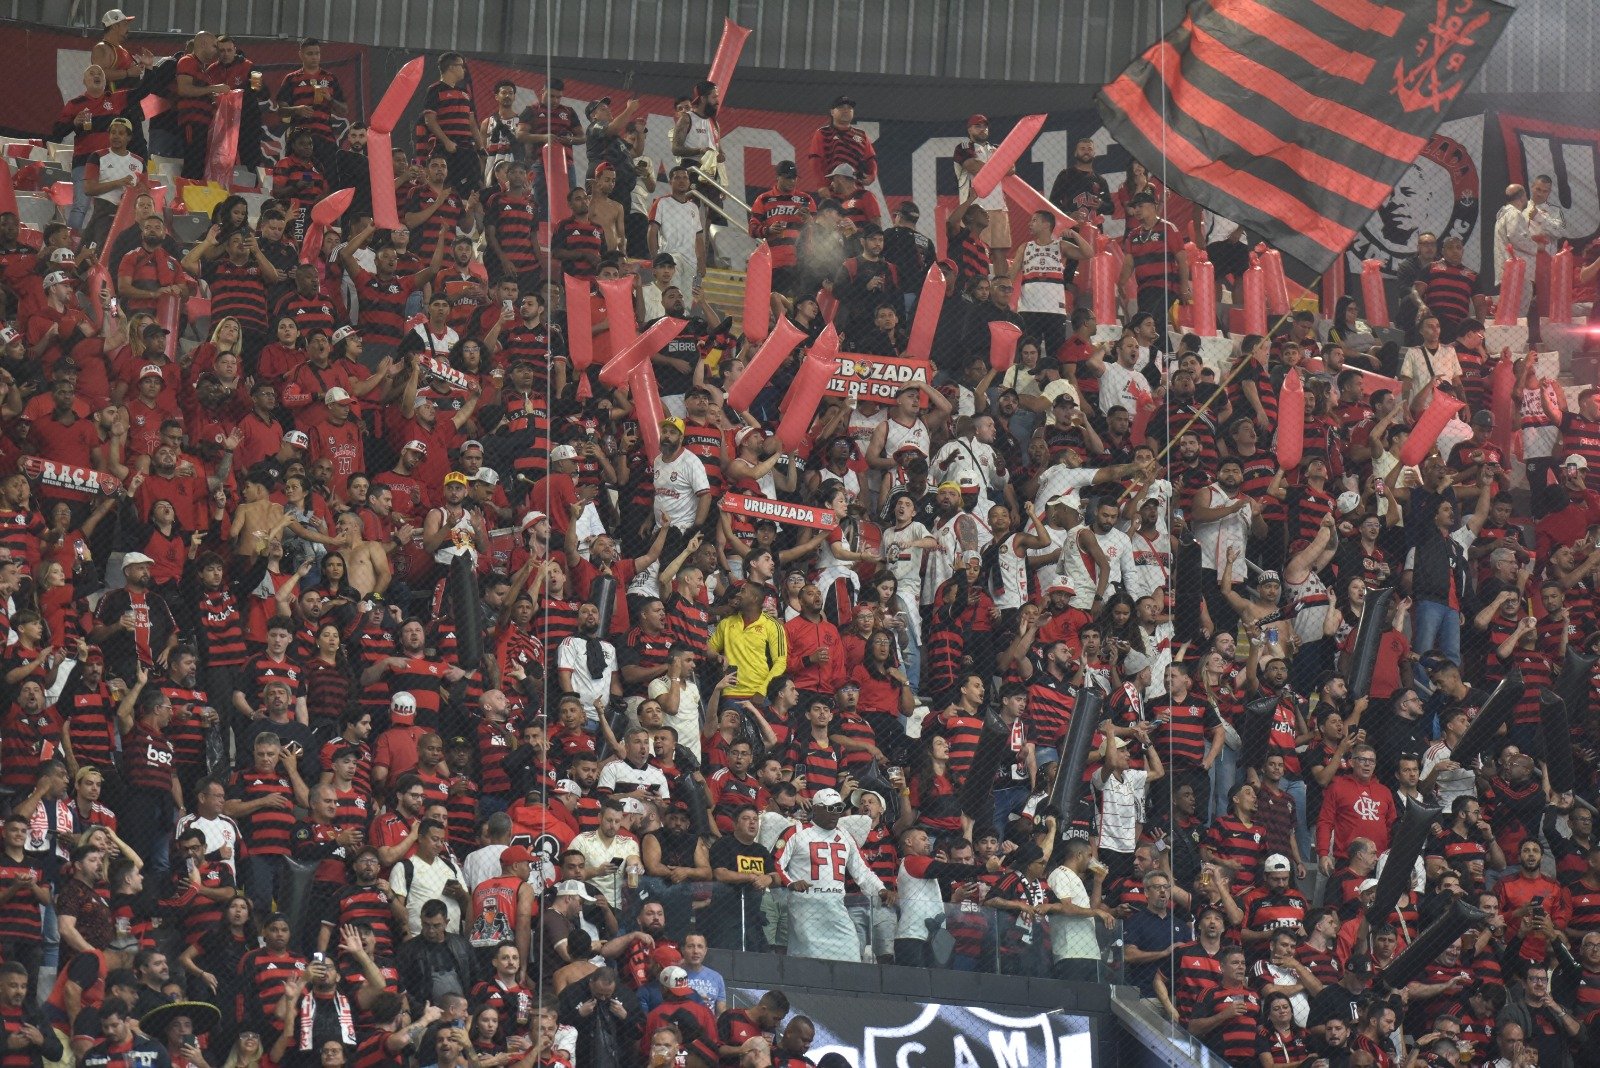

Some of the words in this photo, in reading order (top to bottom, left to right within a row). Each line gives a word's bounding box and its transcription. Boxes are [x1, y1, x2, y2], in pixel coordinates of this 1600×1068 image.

[42, 461, 100, 489] RAÇA
[743, 498, 814, 523] URUBUZADA
[740, 858, 763, 872] CAT
